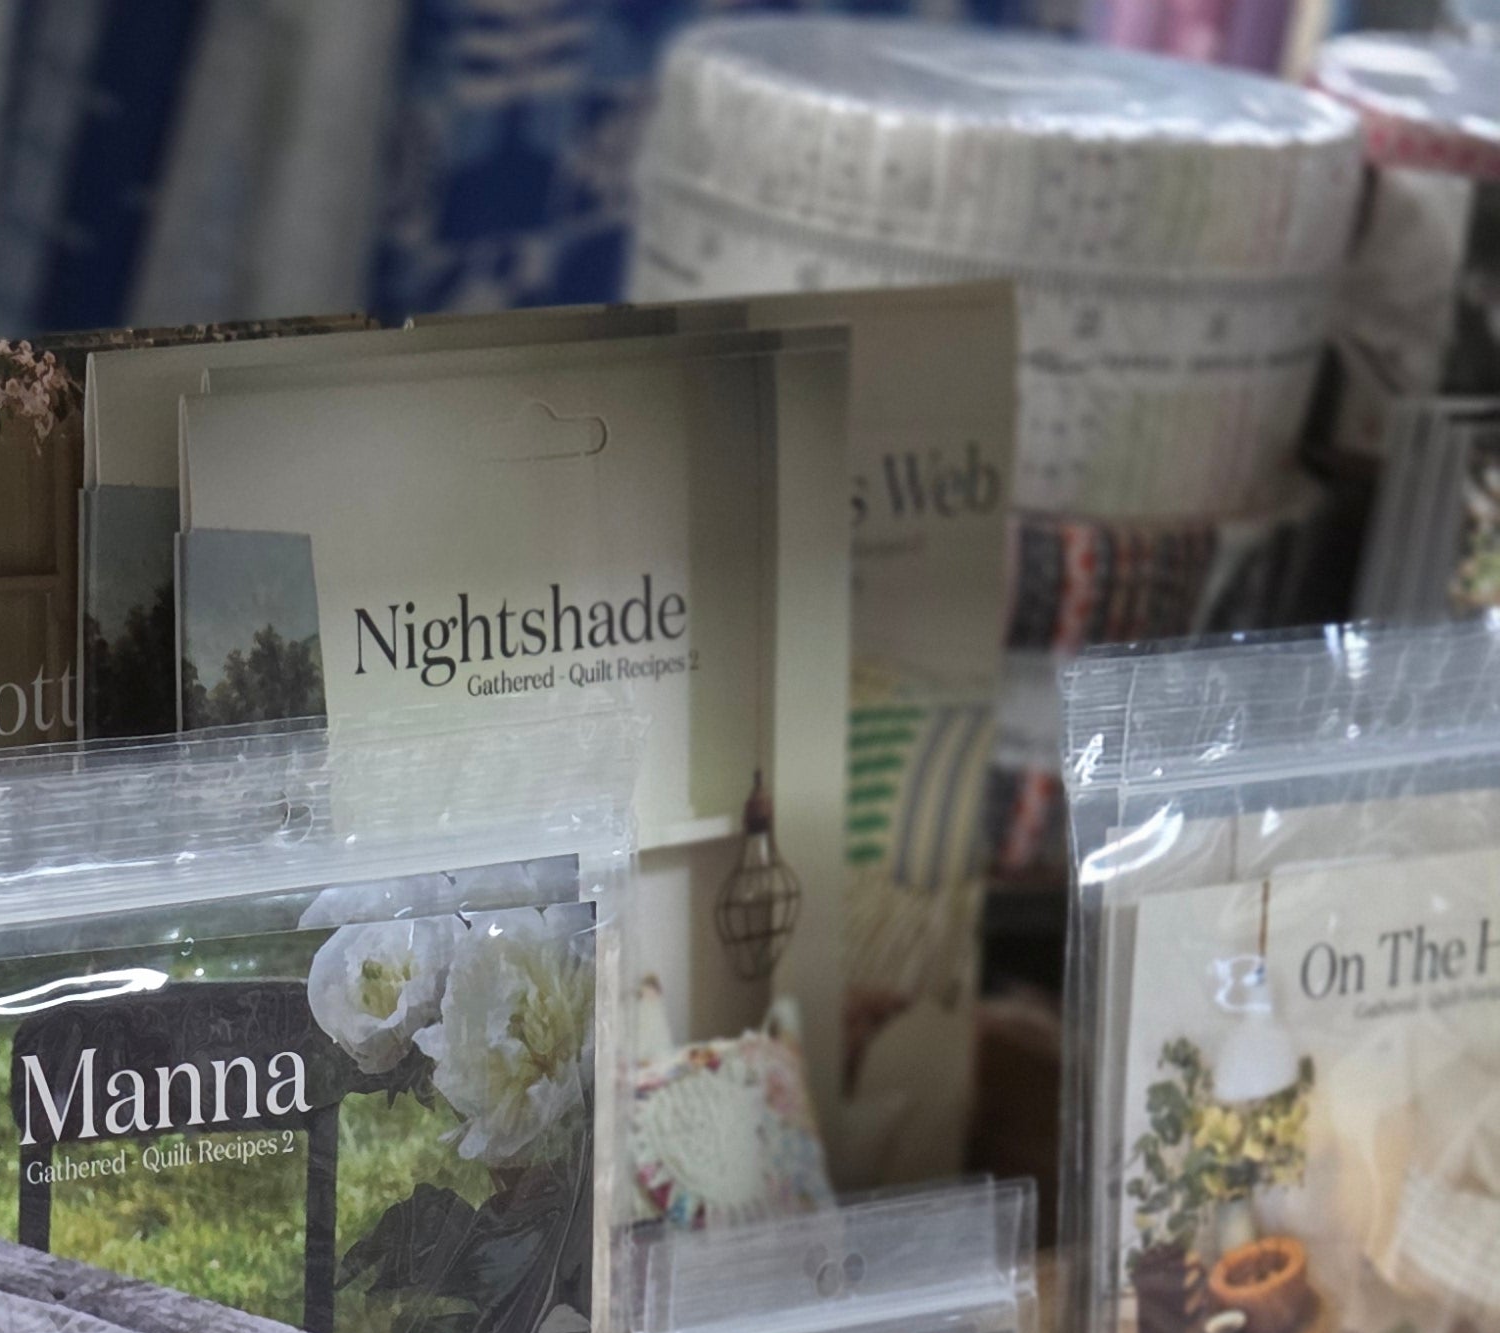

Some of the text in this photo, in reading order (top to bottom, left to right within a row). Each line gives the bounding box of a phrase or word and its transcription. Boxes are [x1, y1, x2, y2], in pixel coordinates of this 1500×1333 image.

[883, 440, 1003, 518] Web
[354, 573, 687, 688] Nightshade
[467, 665, 555, 698] Gathered
[568, 660, 613, 687] Quilt
[617, 653, 686, 682] Recipes
[689, 652, 699, 671] 2
[1300, 941, 1365, 1000] On
[1377, 925, 1467, 988] The
[19, 1048, 313, 1145] Manna
[27, 1149, 126, 1185] Gathered
[142, 1140, 194, 1174] Quilt
[198, 1134, 278, 1166] Recipes
[281, 1129, 295, 1154] 2
